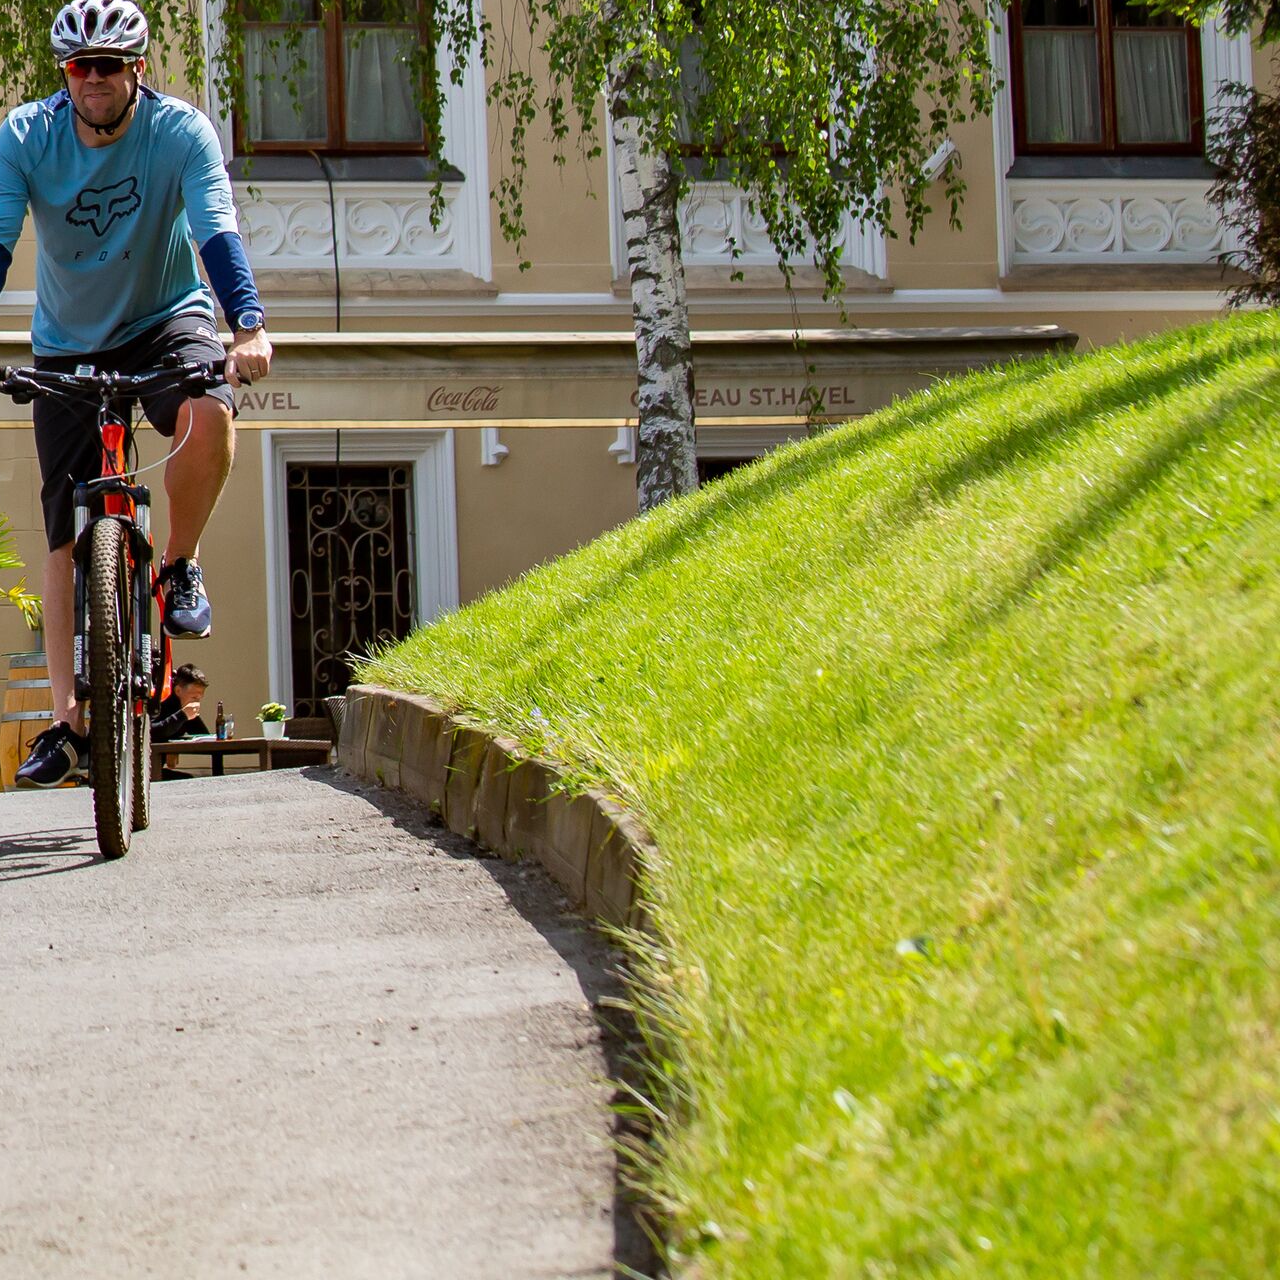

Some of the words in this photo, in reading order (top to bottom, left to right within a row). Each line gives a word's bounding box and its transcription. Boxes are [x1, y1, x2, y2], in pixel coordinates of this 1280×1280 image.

[74, 250, 131, 261] FOX
[238, 392, 300, 410] AVEL
[427, 386, 504, 412] Coca-Cola
[630, 387, 741, 407] CEAU
